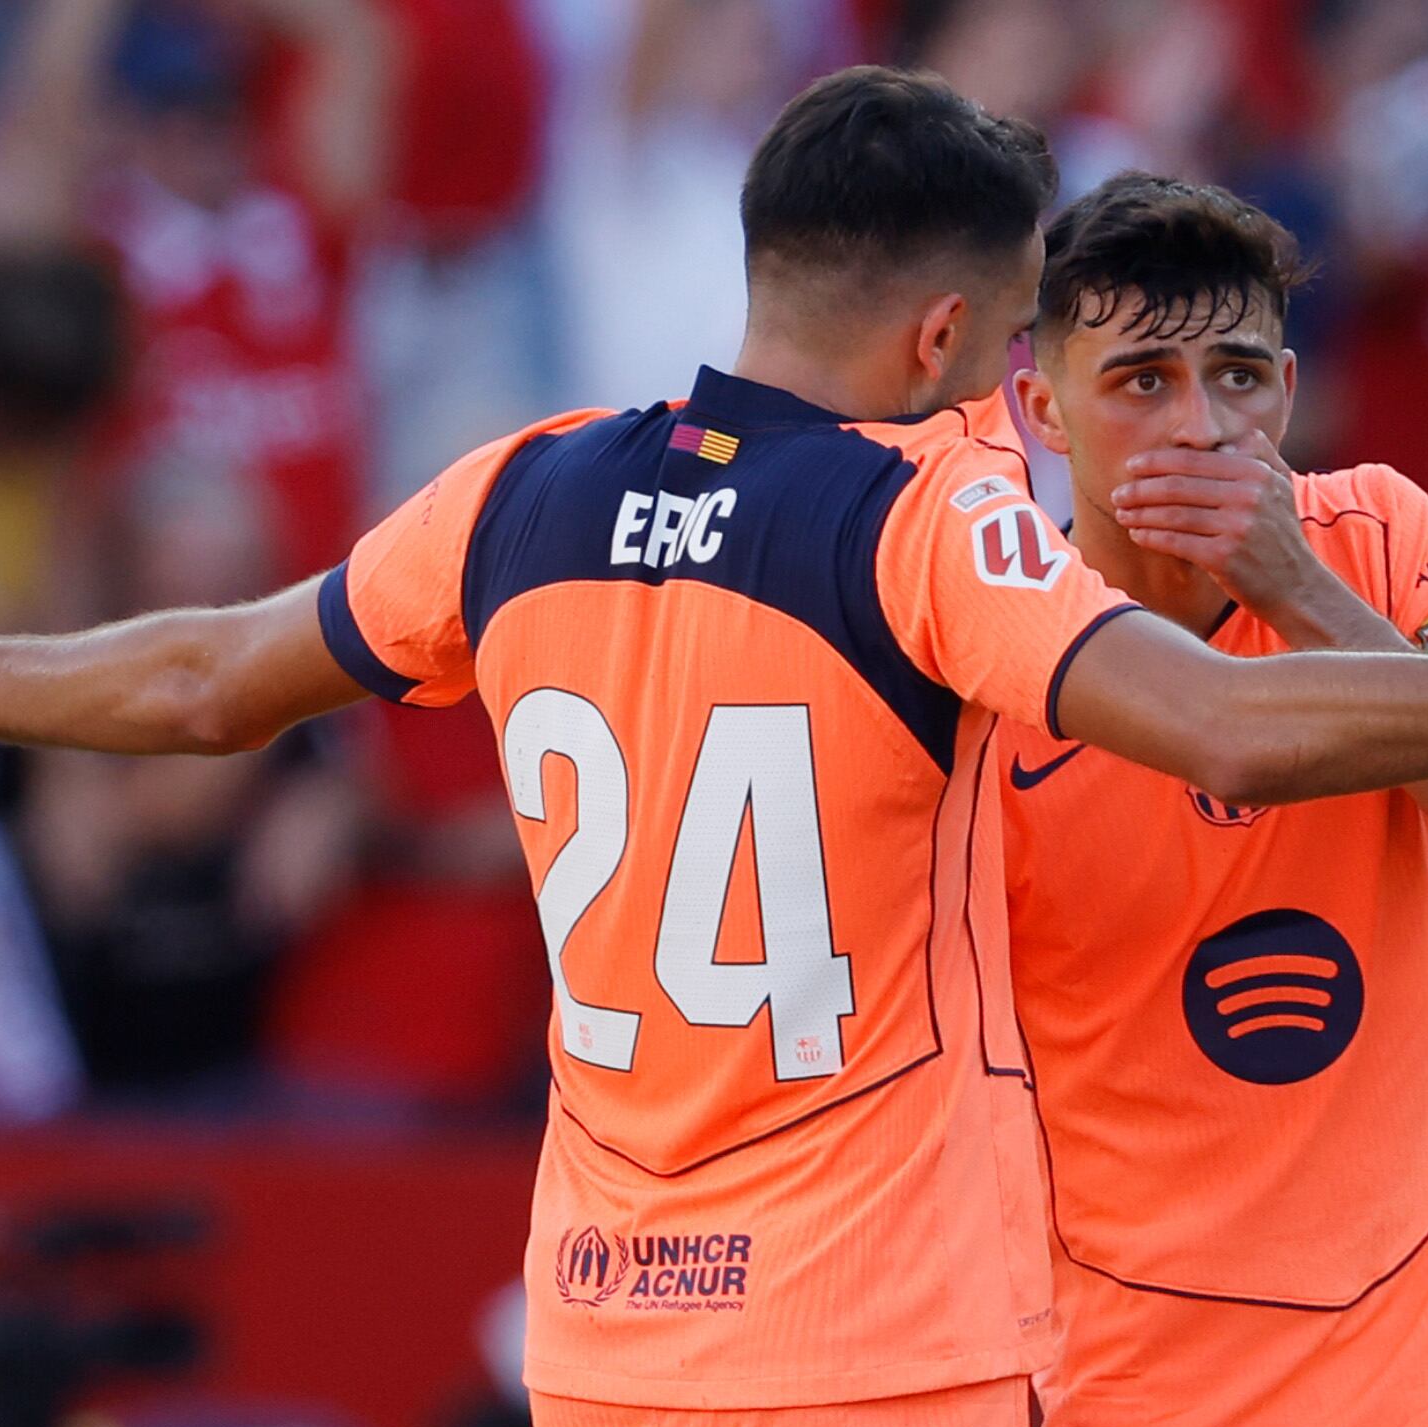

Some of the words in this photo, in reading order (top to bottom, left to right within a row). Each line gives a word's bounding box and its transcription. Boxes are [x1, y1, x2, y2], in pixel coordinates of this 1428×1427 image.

[610, 488, 737, 568] ERIC
[504, 686, 855, 1080] 24
[632, 1234, 752, 1266] UNHCR
[628, 1266, 747, 1297] ACNUR
[625, 1300, 642, 1310] The
[662, 1300, 702, 1312] Refugee
[704, 1299, 745, 1313] Agency
